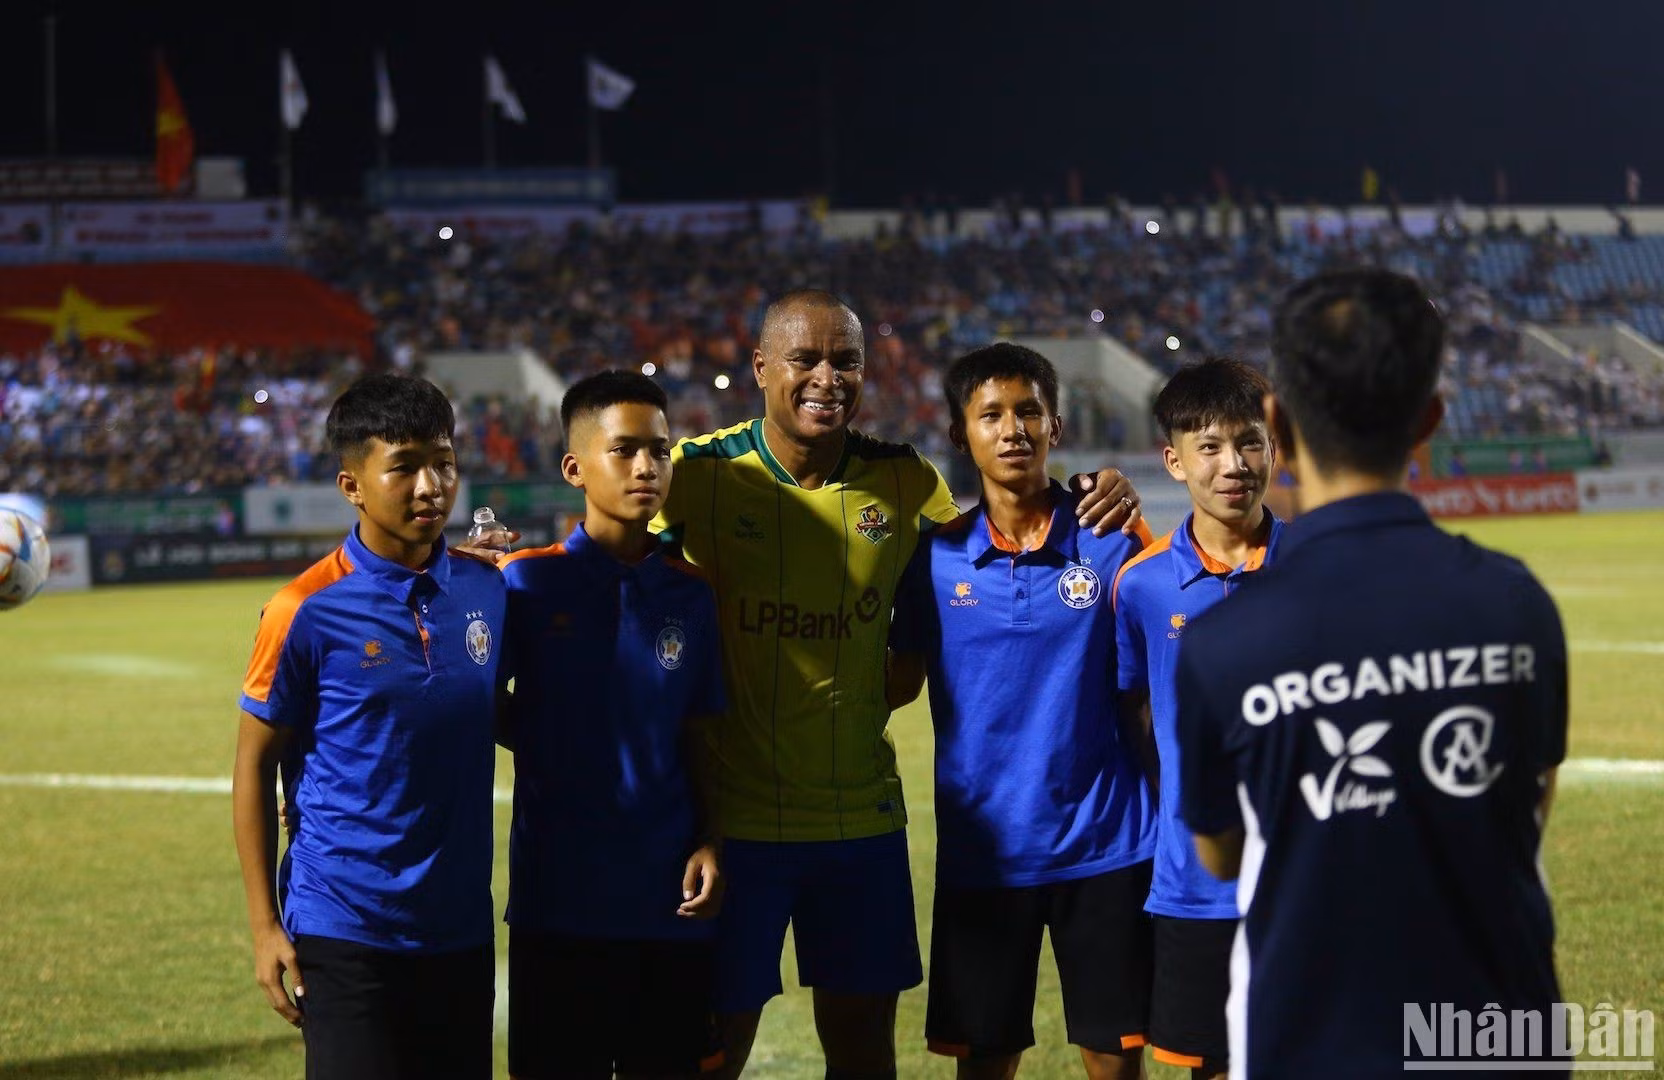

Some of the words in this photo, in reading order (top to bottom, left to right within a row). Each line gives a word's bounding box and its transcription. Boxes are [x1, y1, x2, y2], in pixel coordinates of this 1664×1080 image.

[739, 597, 852, 640] LPBank
[949, 599, 979, 607] GLORY
[1241, 644, 1536, 727] ORGANIZER
